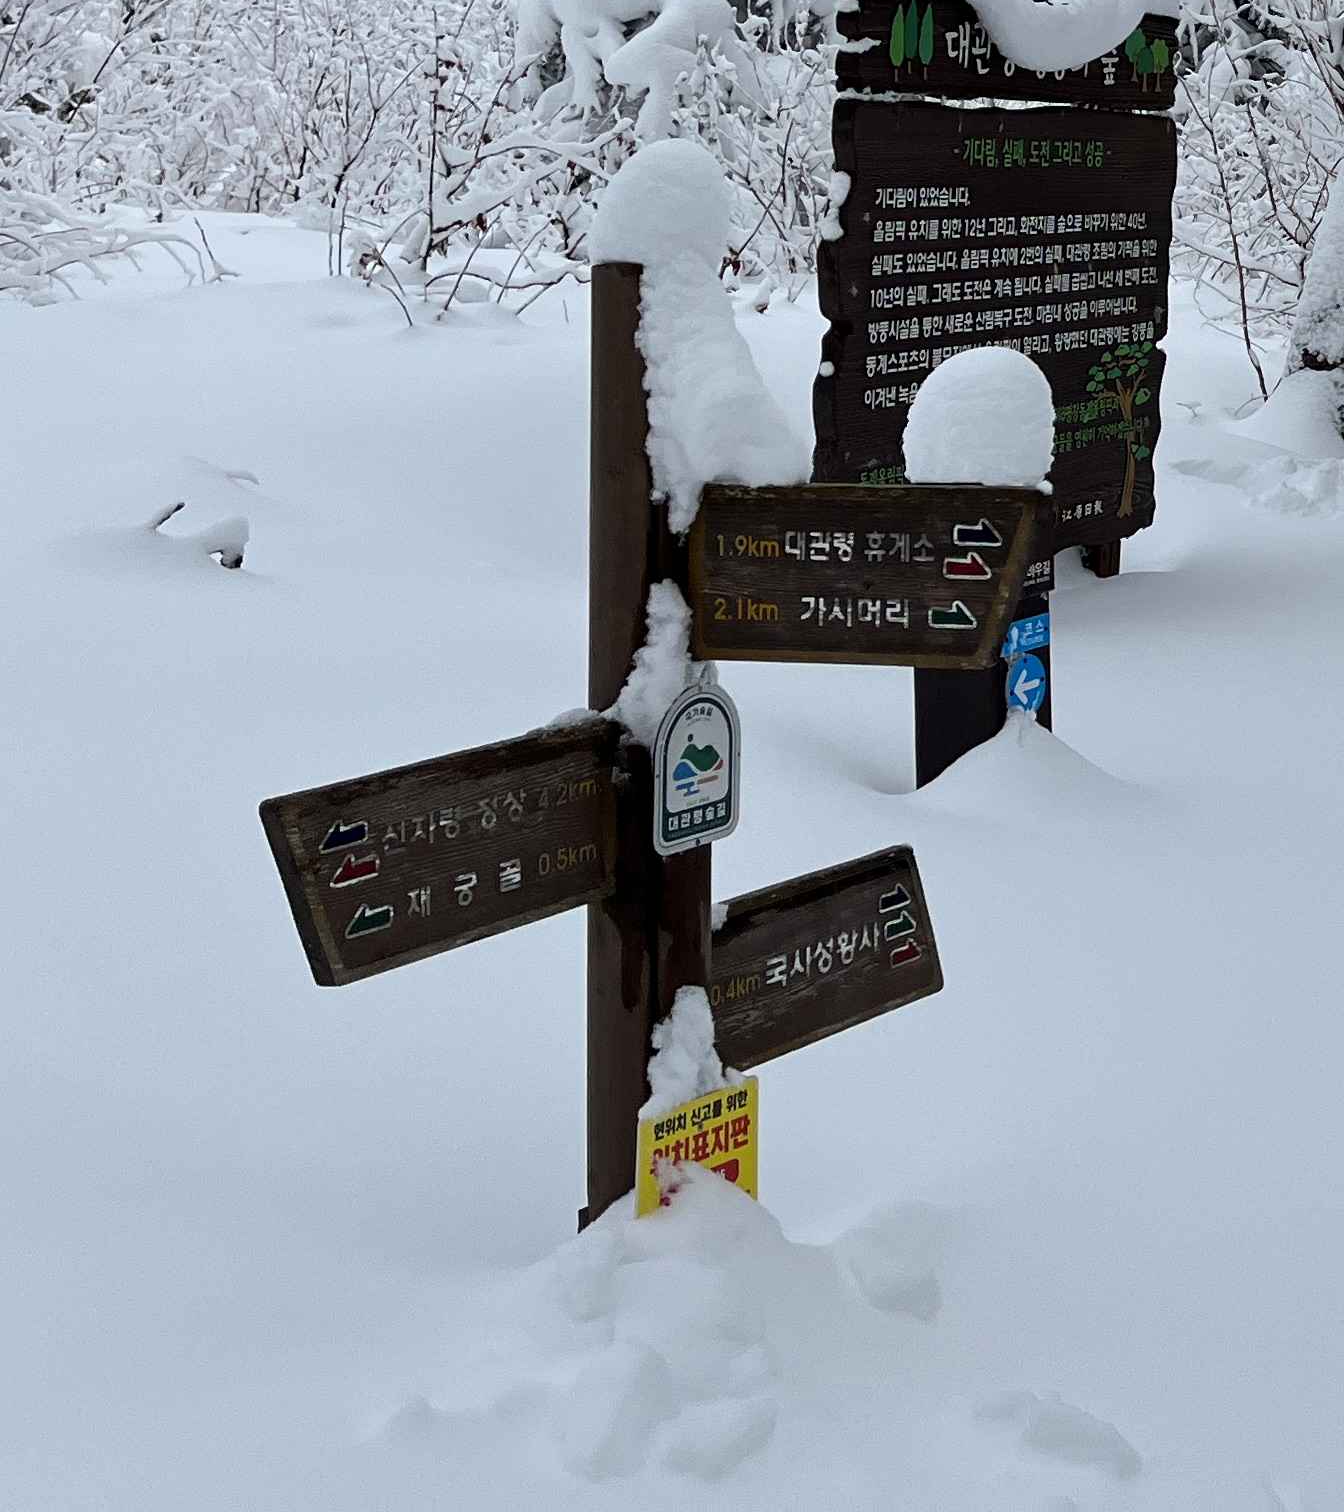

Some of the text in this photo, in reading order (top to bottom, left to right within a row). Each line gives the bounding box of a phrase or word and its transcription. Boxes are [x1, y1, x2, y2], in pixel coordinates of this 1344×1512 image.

[1053, 140, 1082, 167] 그리고
[1085, 140, 1105, 168] 성공
[875, 187, 971, 208] 기다림이 있었습니다.
[873, 220, 906, 242] 올림픽
[908, 219, 939, 241] 유치를
[941, 218, 961, 239] 위한
[964, 217, 986, 238] 12년
[987, 217, 1018, 237] 그리고,
[1057, 214, 1083, 234] 숲으로
[1084, 213, 1109, 232] 바꾸기
[1110, 212, 1127, 231] 위한
[871, 254, 904, 276] 실패도
[906, 251, 958, 273] 있었습니다.
[960, 249, 989, 270] 올림픽
[990, 247, 1018, 268] 유치에
[1020, 246, 1044, 265] 2번의
[1066, 243, 1091, 262] 대관령
[1092, 242, 1117, 261] 조림의
[1118, 240, 1141, 259] 기적을
[1142, 239, 1158, 257] 위한
[870, 286, 905, 309] 10년의
[932, 282, 962, 303] 그래도
[963, 279, 992, 300] 도전은
[994, 278, 1012, 298] 계속
[1045, 273, 1070, 293] 실패를
[1098, 270, 1114, 289] 나선
[1115, 269, 1123, 287] 세
[868, 317, 920, 344] 방풍시설을
[922, 316, 943, 338] 통한
[944, 312, 974, 334] 새로운
[975, 309, 1013, 331] 산림복구
[1036, 304, 1062, 324] 마침내
[1064, 301, 1088, 322] 성공을
[866, 349, 930, 378] 동계스포츠의
[1054, 330, 1088, 353] 황량했던
[1090, 326, 1129, 347] 대관령에는
[1131, 321, 1154, 342] 강풍을
[864, 386, 897, 410] 이겨낸
[717, 530, 936, 563] 1.9km 대관령 휴게소
[714, 596, 910, 630] 2.1km 가시머리
[538, 843, 598, 876] 0.5km
[654, 1090, 748, 1141] 현위치 신고를 위한
